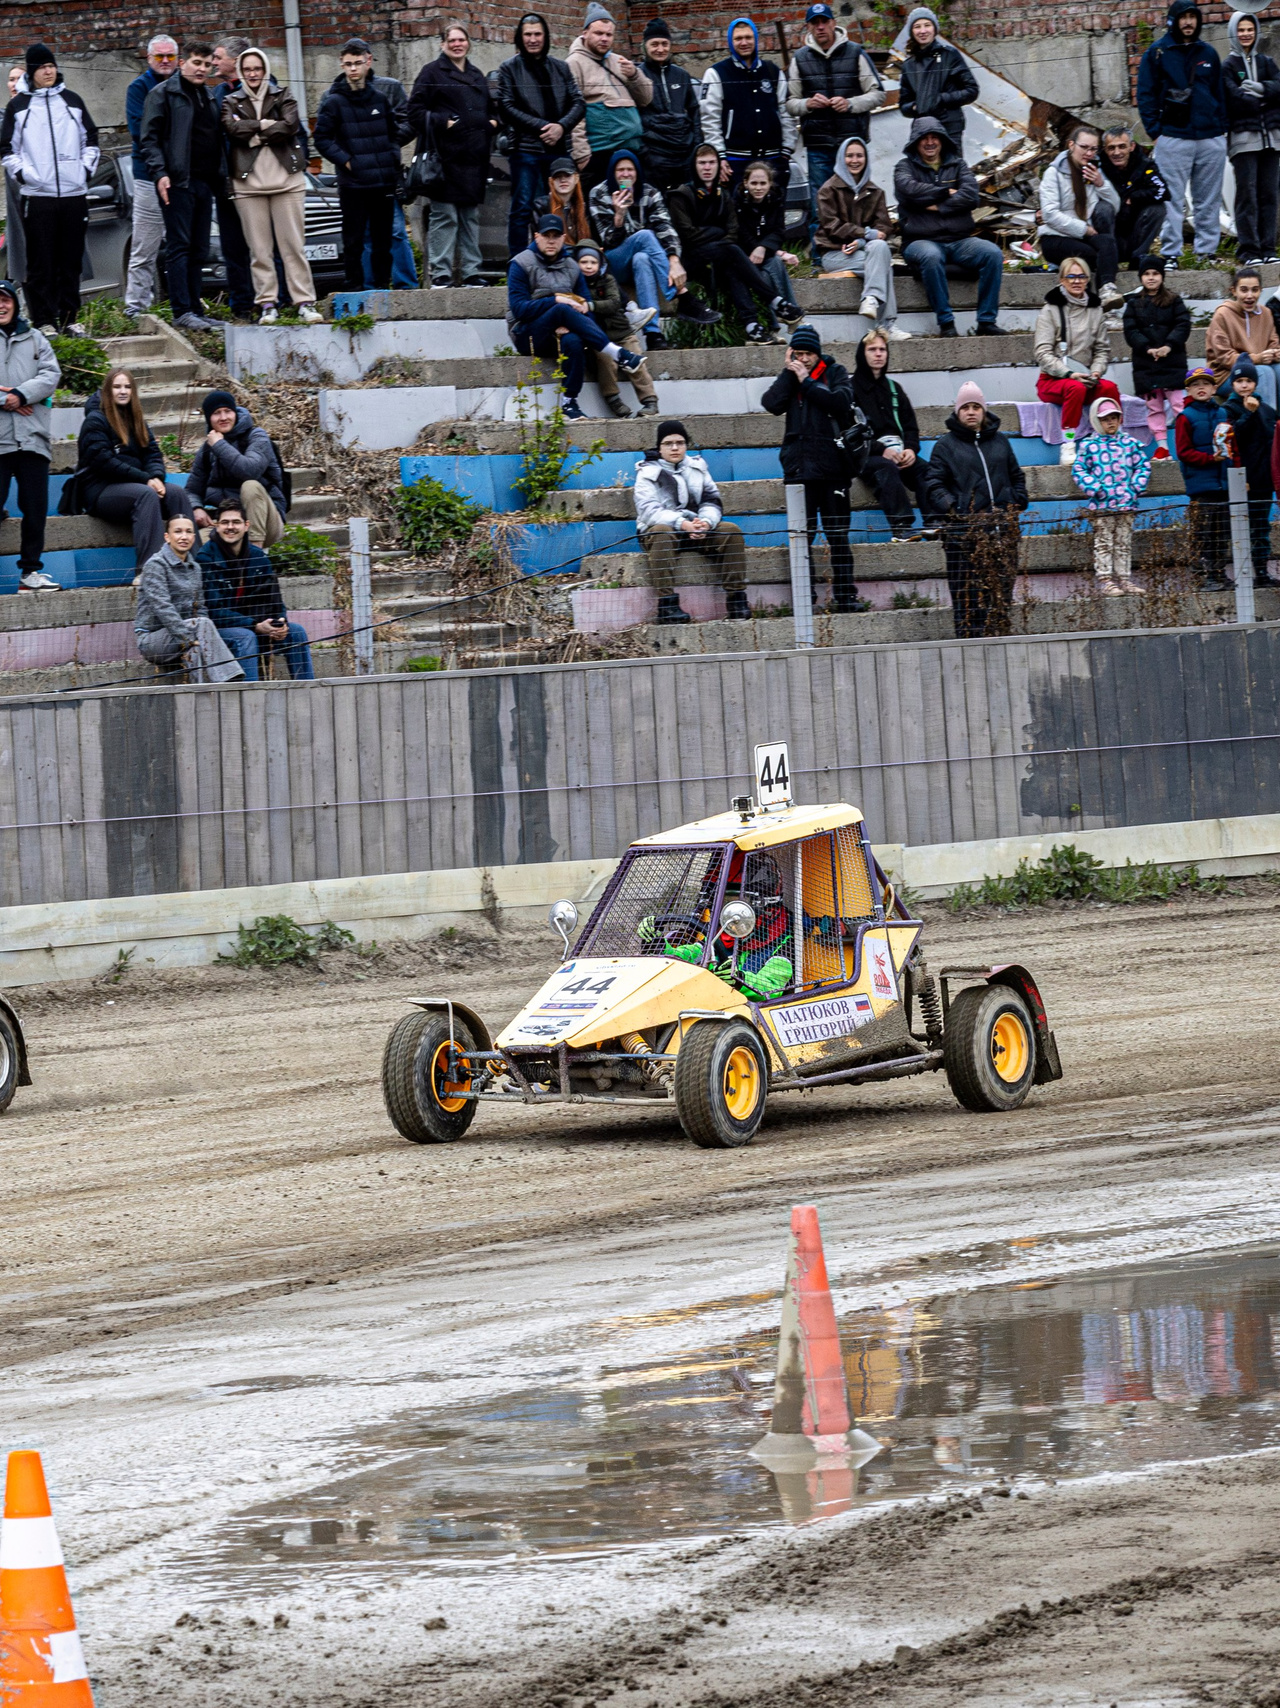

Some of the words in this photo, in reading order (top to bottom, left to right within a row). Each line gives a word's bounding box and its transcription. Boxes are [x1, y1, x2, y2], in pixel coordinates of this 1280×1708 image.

[760, 753, 789, 793] 44
[561, 976, 617, 995] 44
[779, 1000, 850, 1025] МАТЮКОВ
[785, 1015, 857, 1044] ГРИГОРИЙ
